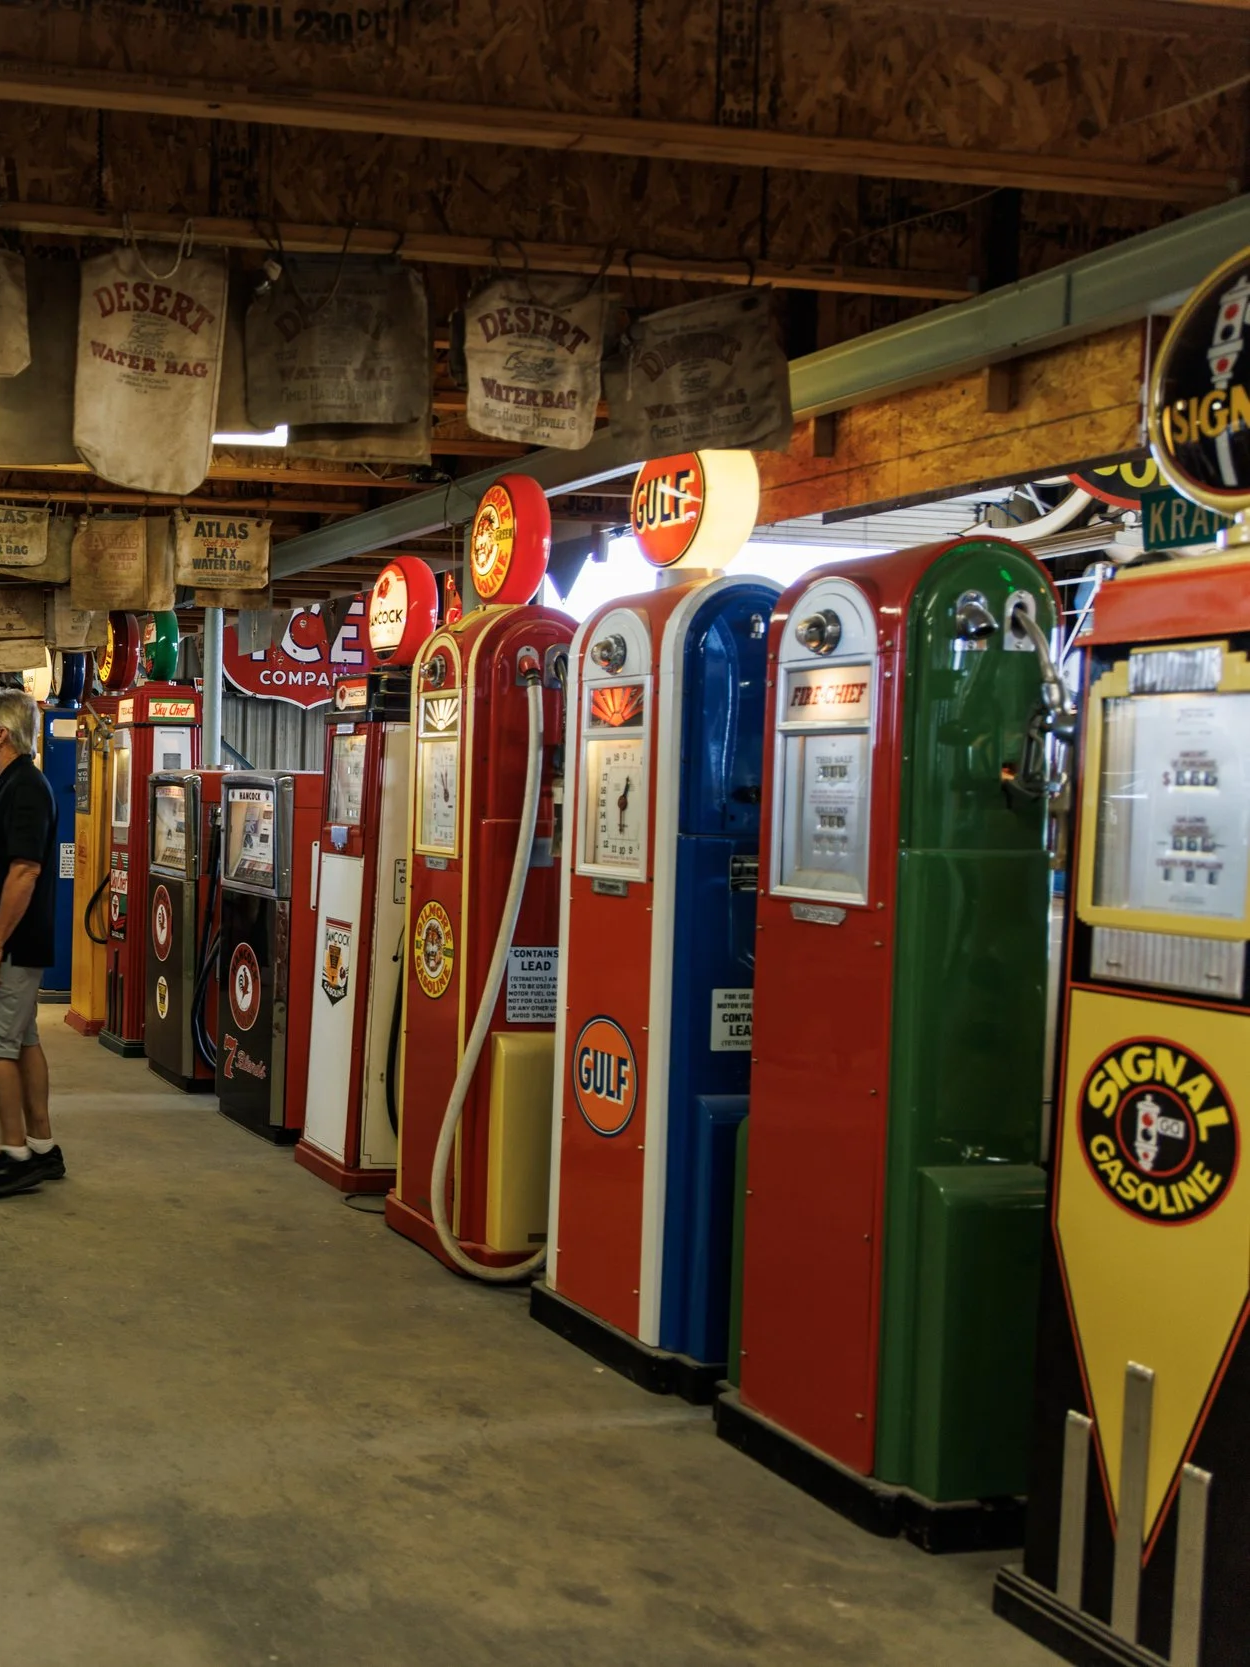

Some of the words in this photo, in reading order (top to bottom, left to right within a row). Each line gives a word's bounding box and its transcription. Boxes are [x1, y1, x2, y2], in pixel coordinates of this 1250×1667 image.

[293, 9, 354, 43] 230
[92, 281, 216, 335] DESERT
[477, 305, 591, 355] DESERT
[90, 340, 157, 373] WATER
[164, 360, 209, 378] BAG
[636, 332, 743, 382] DESERT
[480, 376, 539, 408] WATER
[540, 389, 578, 410] BAG
[501, 406, 531, 427] HARRIS
[532, 408, 566, 430] NEVILLE
[1171, 382, 1250, 446] SIGN
[635, 467, 696, 536] GULF
[194, 520, 249, 540] ATLAS
[5, 545, 29, 555] BAG
[90, 533, 140, 551] ATLAS
[205, 546, 237, 560] FLAX
[191, 558, 227, 571] WATER
[229, 560, 252, 572] BAG
[369, 609, 403, 627] HANCOCK
[259, 670, 361, 687] COMPAN
[152, 703, 167, 716] Sky
[169, 703, 191, 717] Chief
[1162, 771, 1170, 787] $
[239, 791, 261, 801] HANCOCK
[815, 805, 848, 815] GALLONS
[603, 840, 610, 849] 12
[619, 846, 626, 856] 10
[628, 846, 634, 856] 9
[415, 900, 453, 942] GILMORE
[326, 930, 351, 946] HANCOCK
[514, 949, 559, 958] CONTAINS
[415, 954, 452, 996] GASOLINE
[521, 961, 551, 971] LEAD
[323, 979, 347, 998] GASOLINE
[223, 1034, 238, 1079] 7
[578, 1047, 631, 1106] GULF
[1087, 1044, 1230, 1143] SIGNAL
[1159, 1119, 1181, 1135] GO
[1089, 1133, 1223, 1215] GASOLINE
